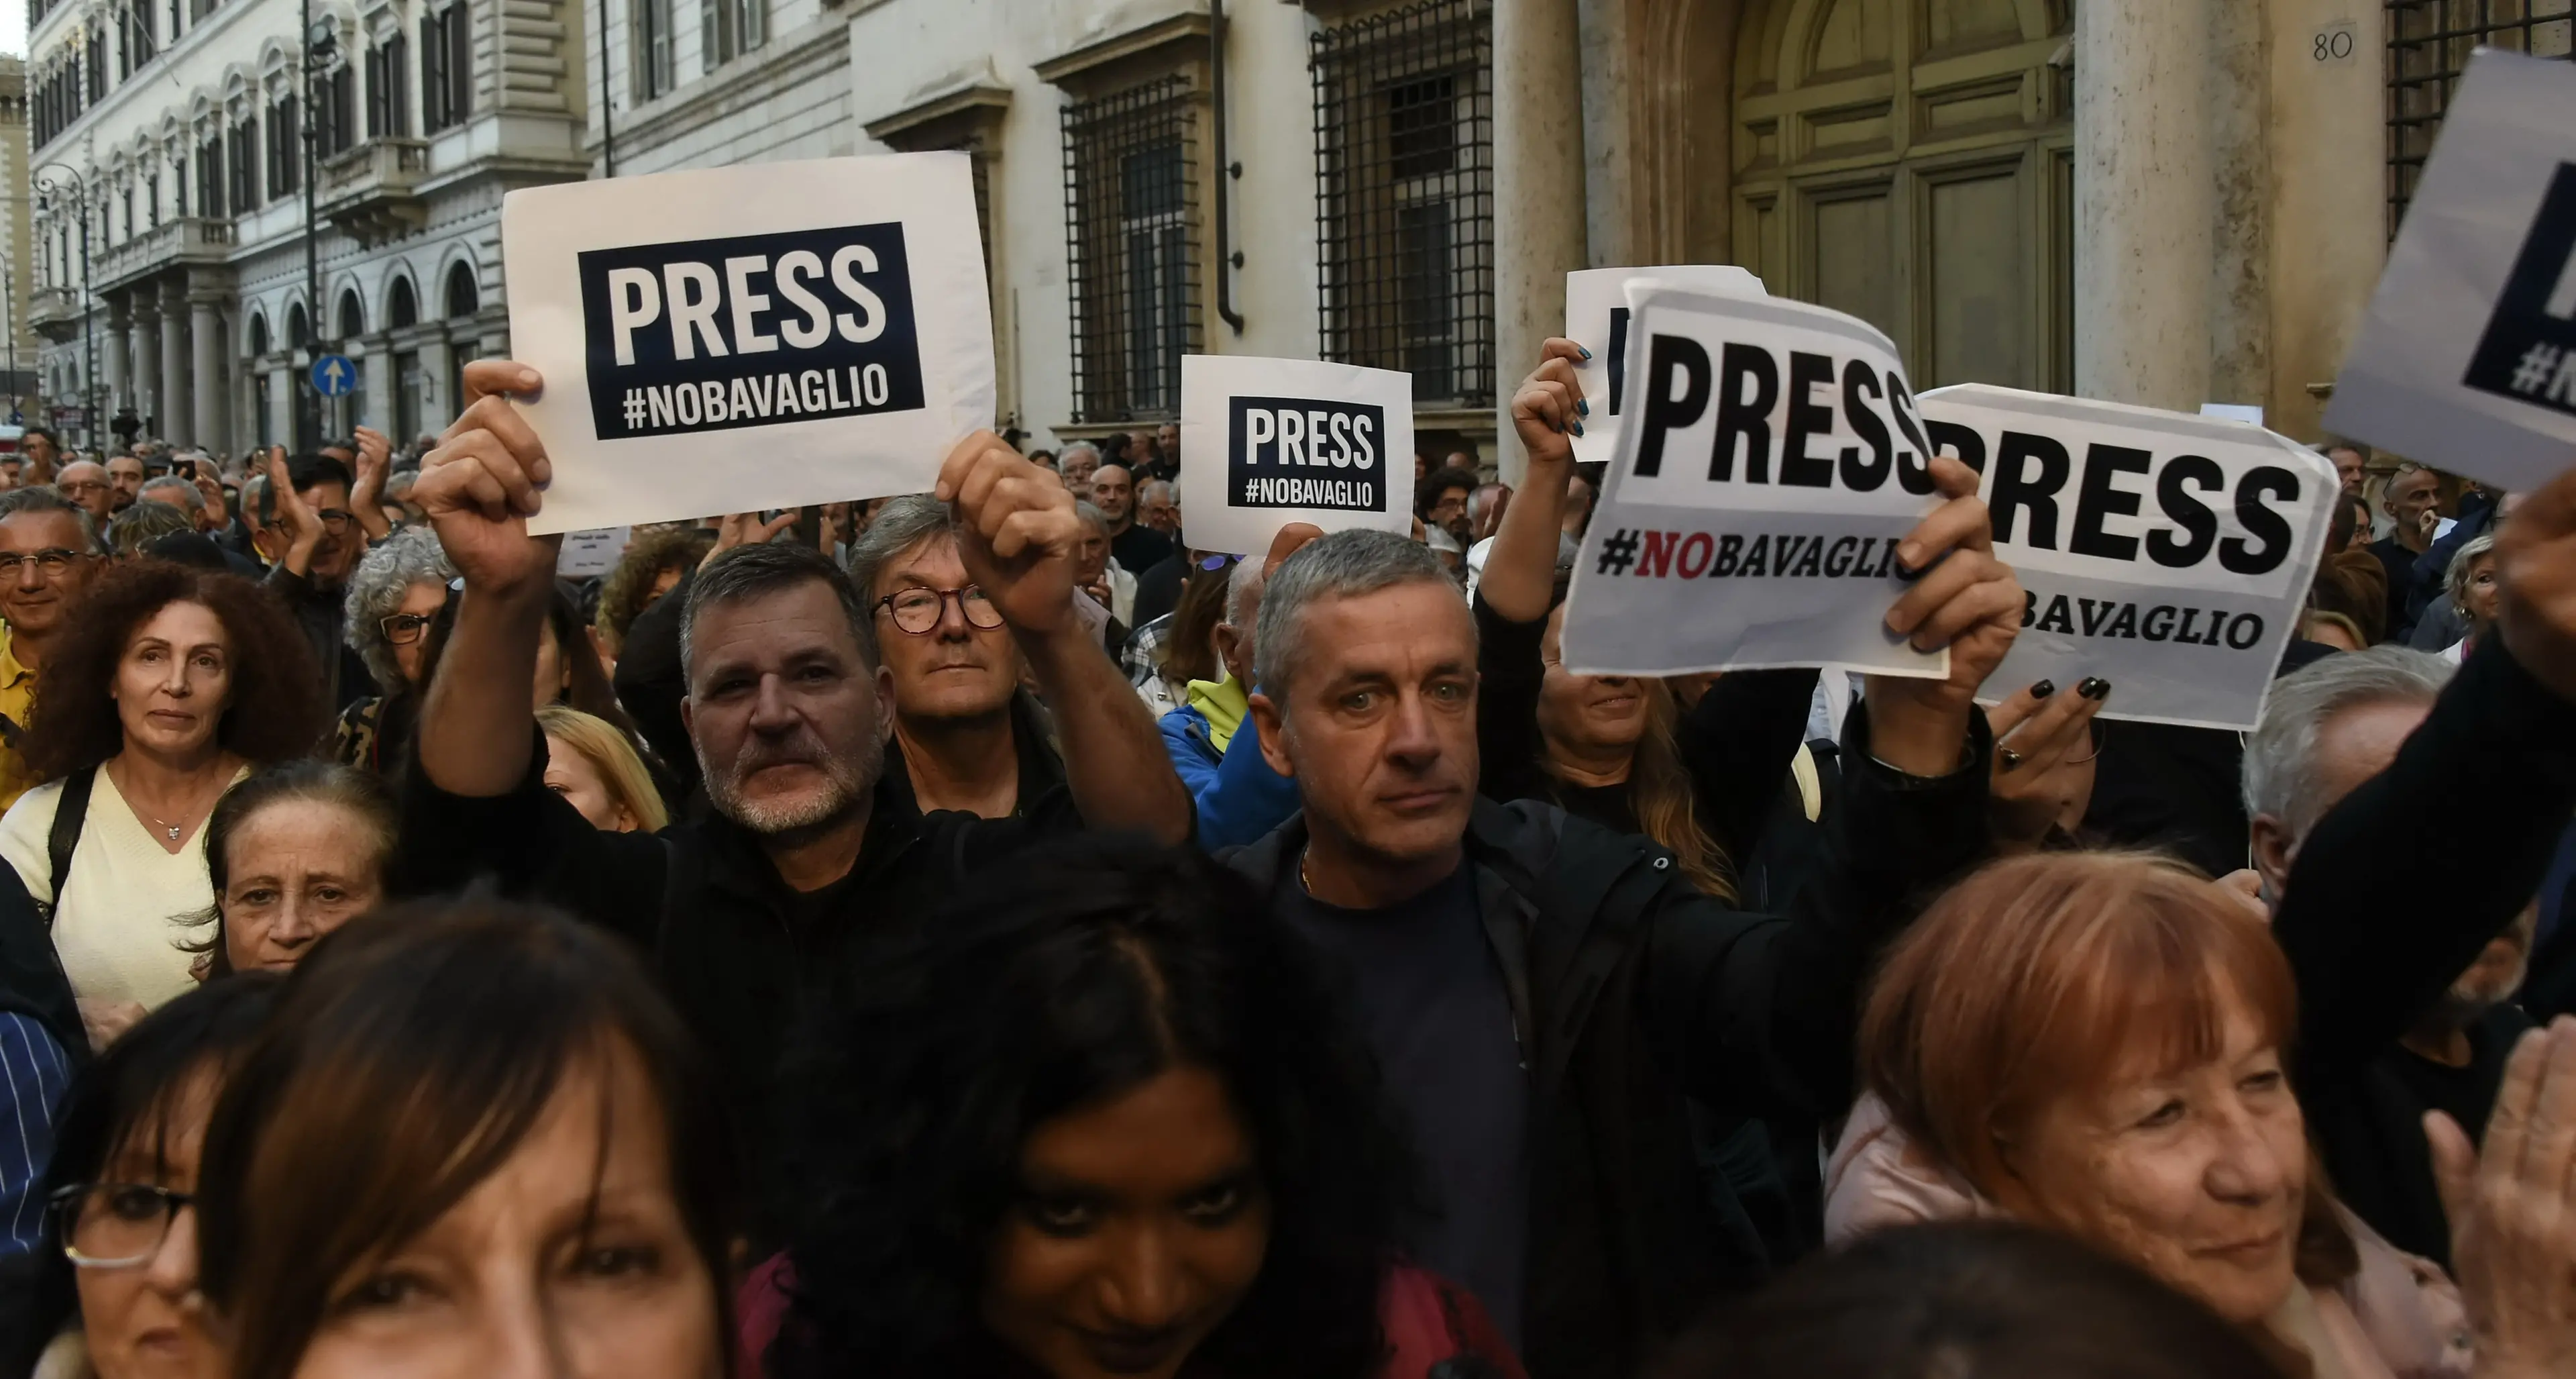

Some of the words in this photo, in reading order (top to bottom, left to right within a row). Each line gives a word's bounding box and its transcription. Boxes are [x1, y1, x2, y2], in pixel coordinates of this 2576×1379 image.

[2314, 31, 2353, 62] 80
[608, 244, 887, 366] PRESS
[623, 363, 889, 429] #NOBAVAGLIO
[1633, 333, 1937, 495] PRESS
[1246, 408, 1375, 470] PRESS
[1245, 478, 1373, 507] #NOBAVAGLIO
[1597, 528, 1917, 581] #NOBAVAGLI
